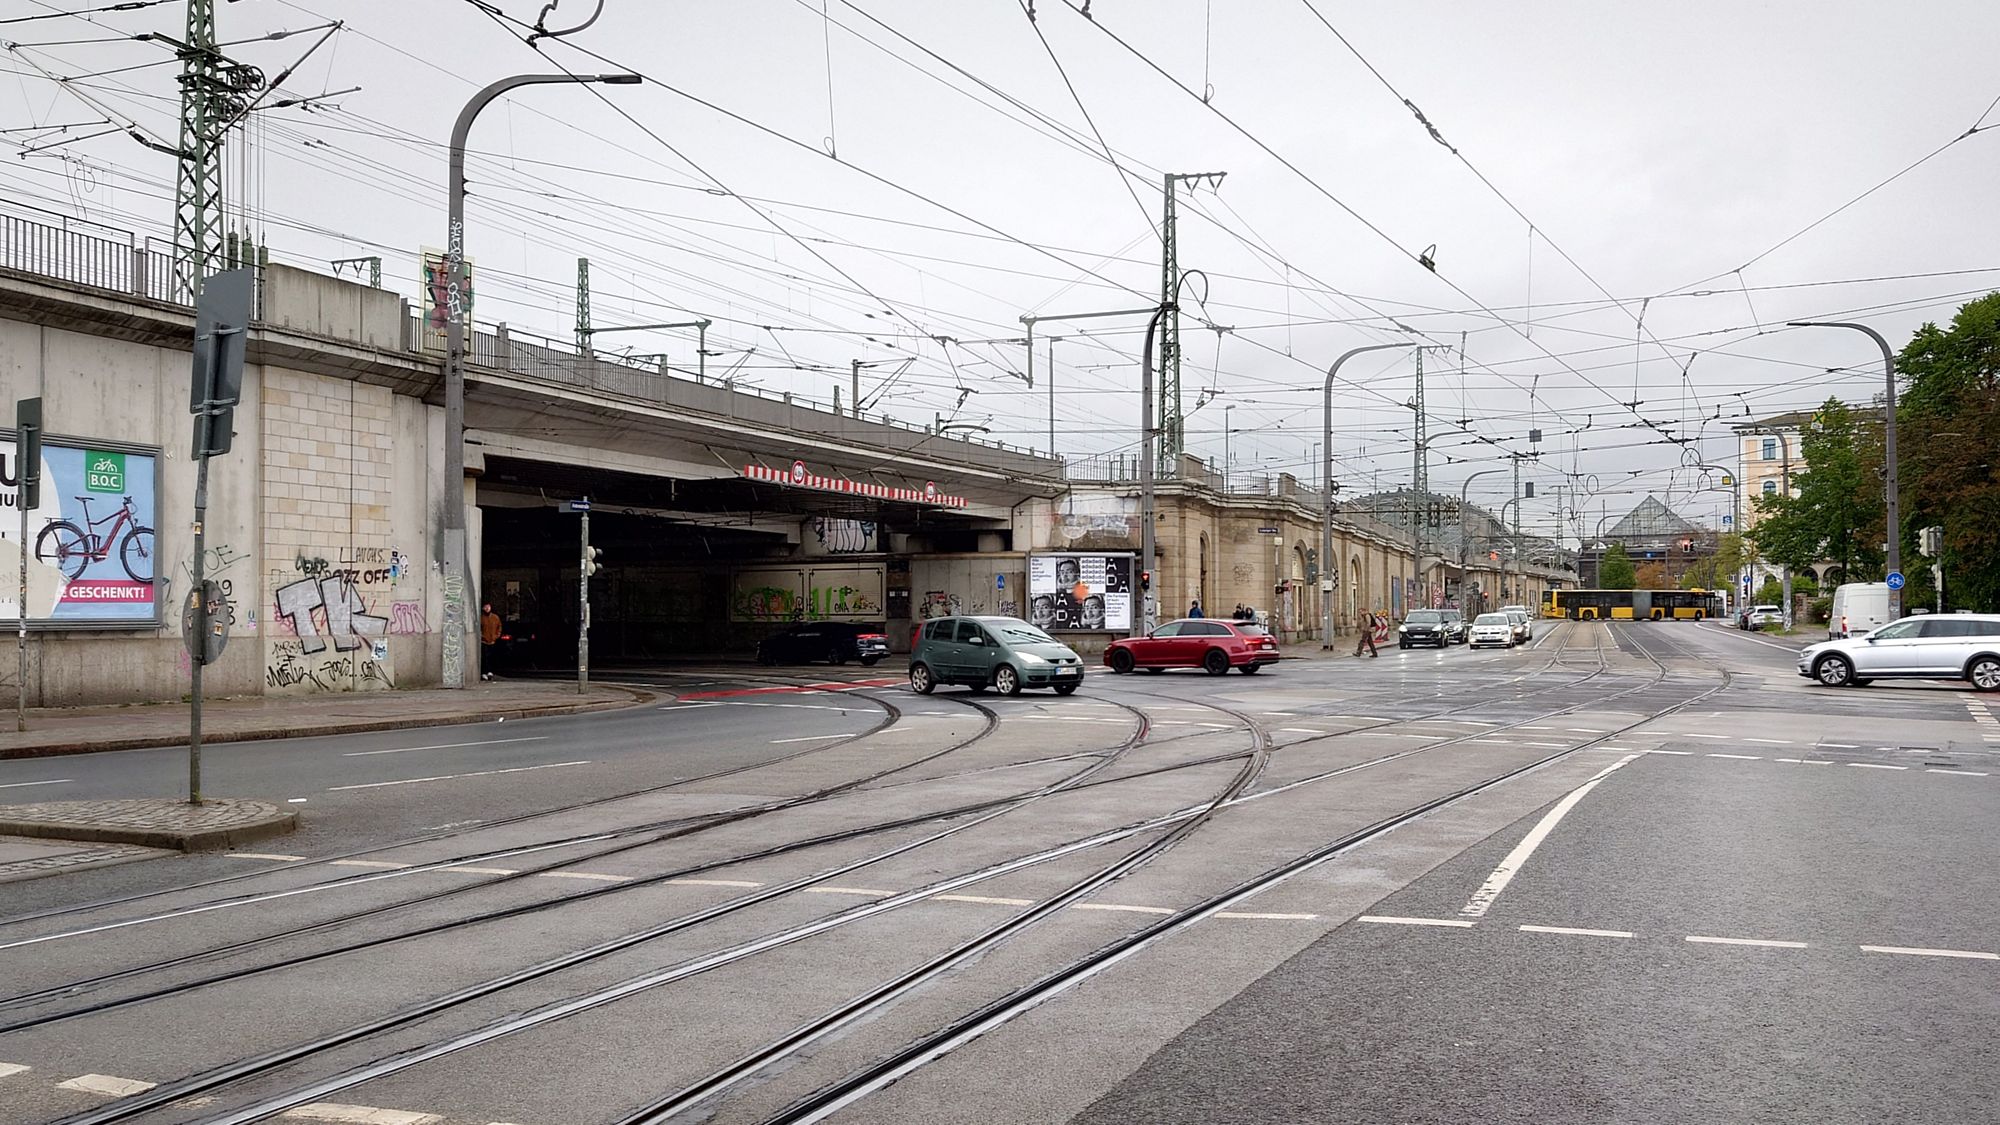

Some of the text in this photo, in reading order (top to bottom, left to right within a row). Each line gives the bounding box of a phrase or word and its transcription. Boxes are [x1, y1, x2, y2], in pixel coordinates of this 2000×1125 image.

[91, 474, 120, 488] B.O.C.
[363, 568, 390, 584] OFF
[70, 586, 145, 599] GESCHENKT!
[276, 576, 389, 655] TK
